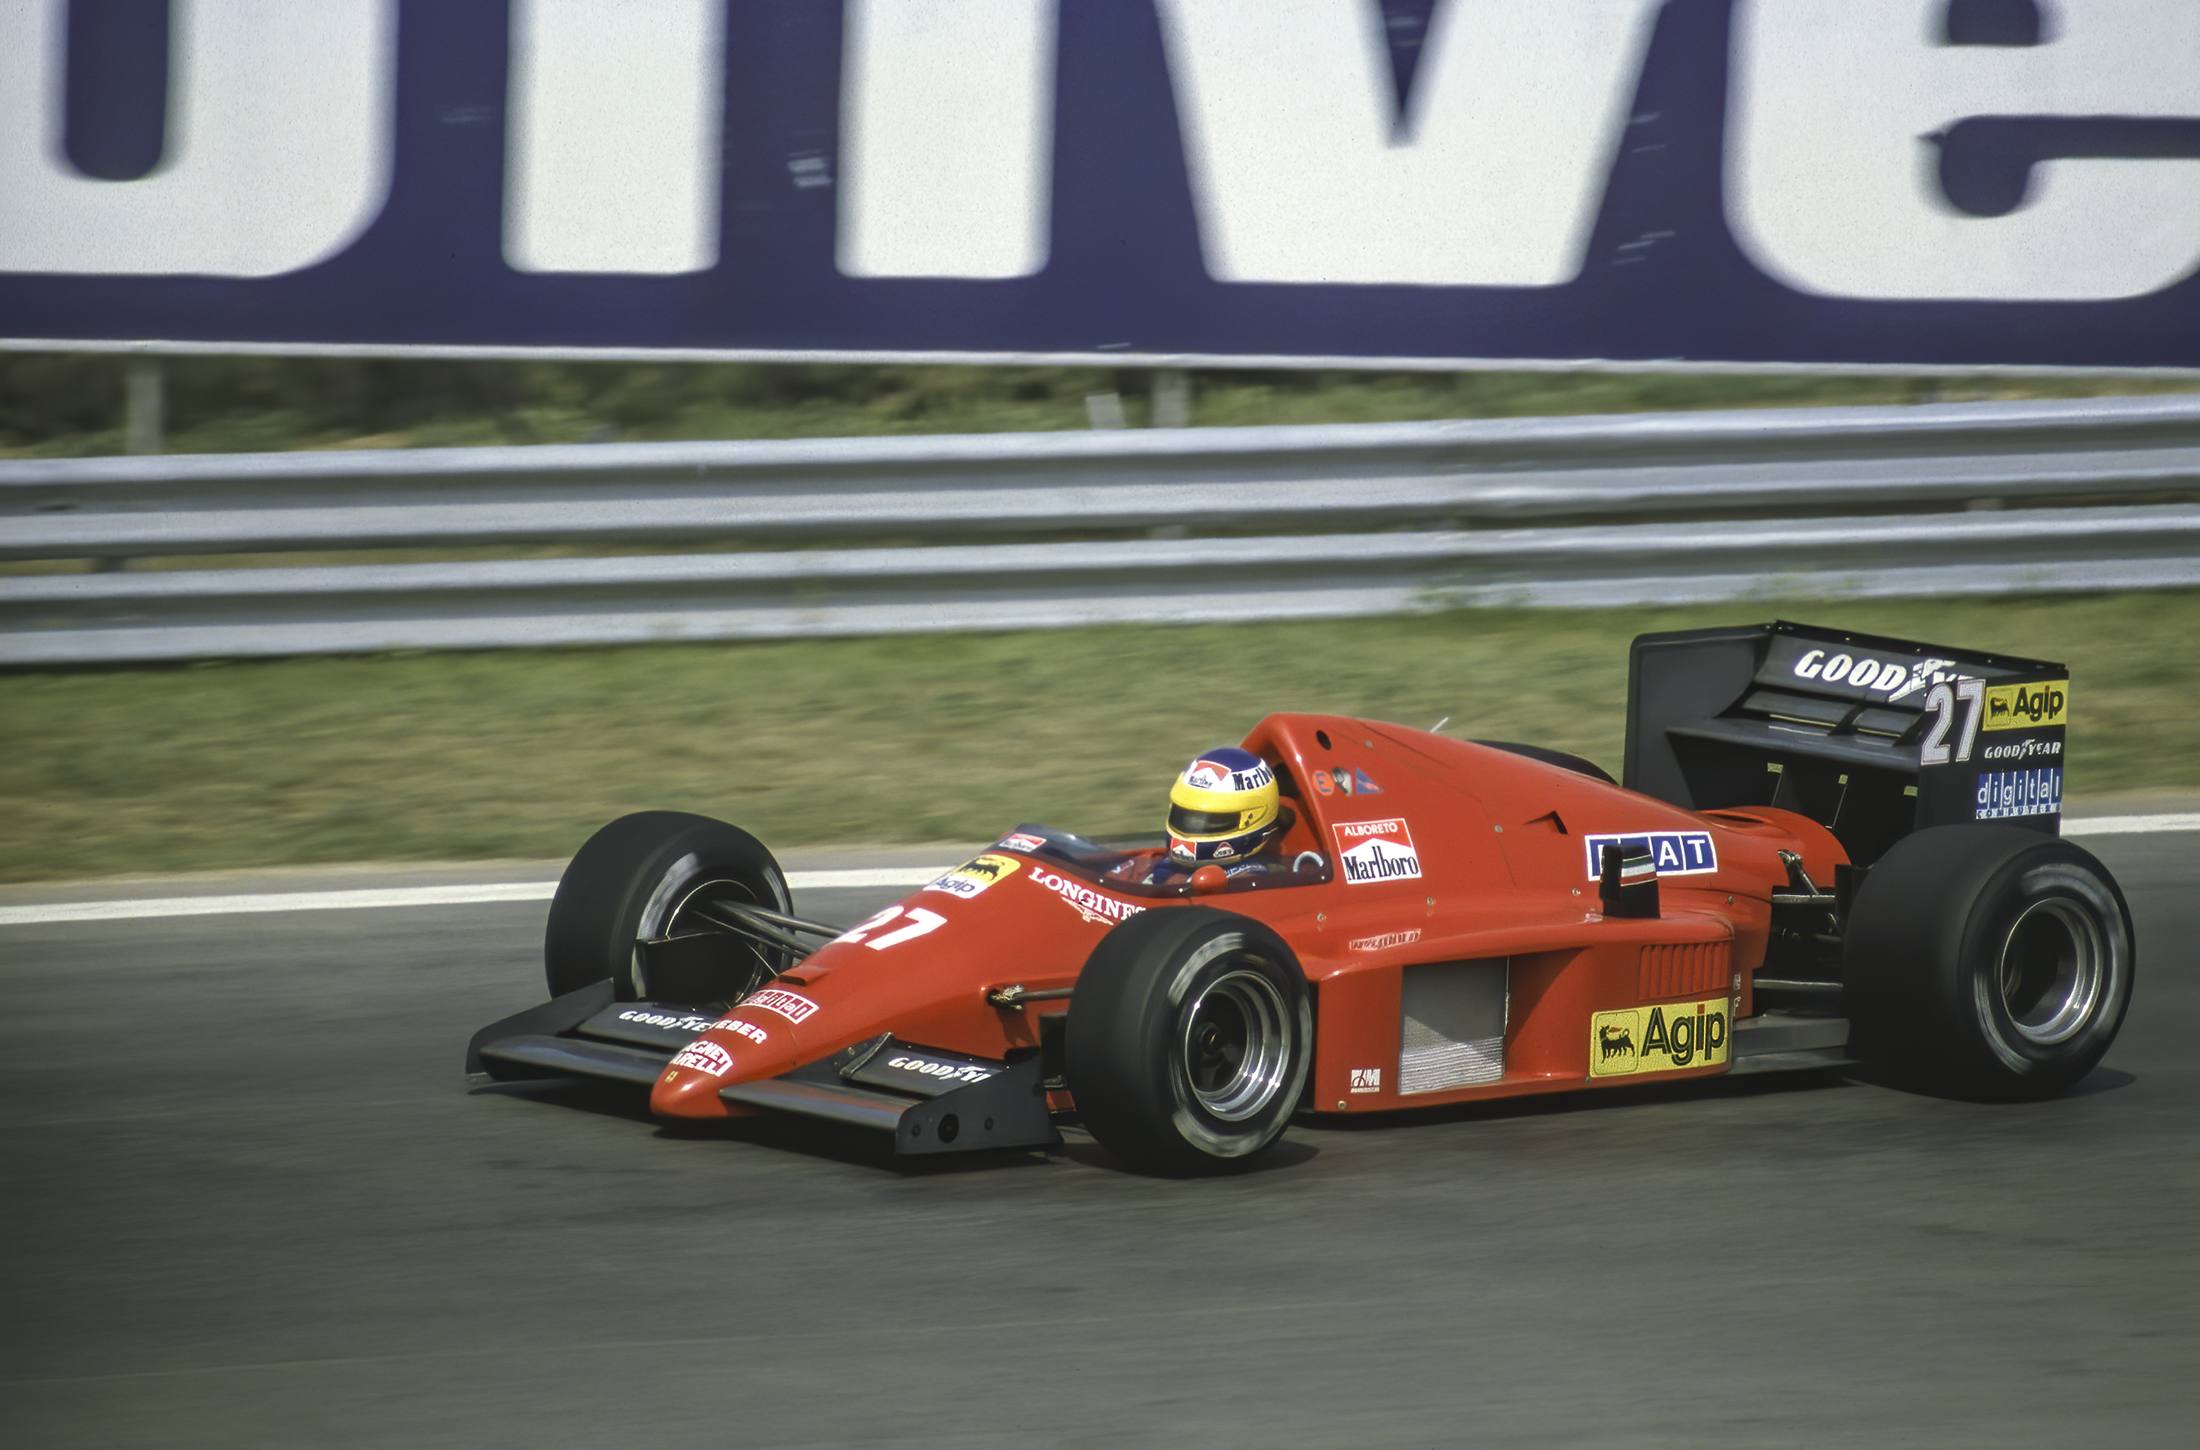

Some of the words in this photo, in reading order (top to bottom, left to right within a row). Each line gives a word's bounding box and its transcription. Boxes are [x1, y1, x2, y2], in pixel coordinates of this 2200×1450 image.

[1921, 678, 1986, 766] 27
[2013, 685, 2064, 723] Agip
[1984, 738, 2062, 760] GOODYEAR
[1315, 771, 1332, 793] E
[1977, 775, 2060, 806] digital
[1344, 821, 1398, 836] ALBORETO
[1342, 845, 1419, 882] Marlboro
[828, 905, 948, 951] 27
[1641, 1004, 1725, 1066] Agip
